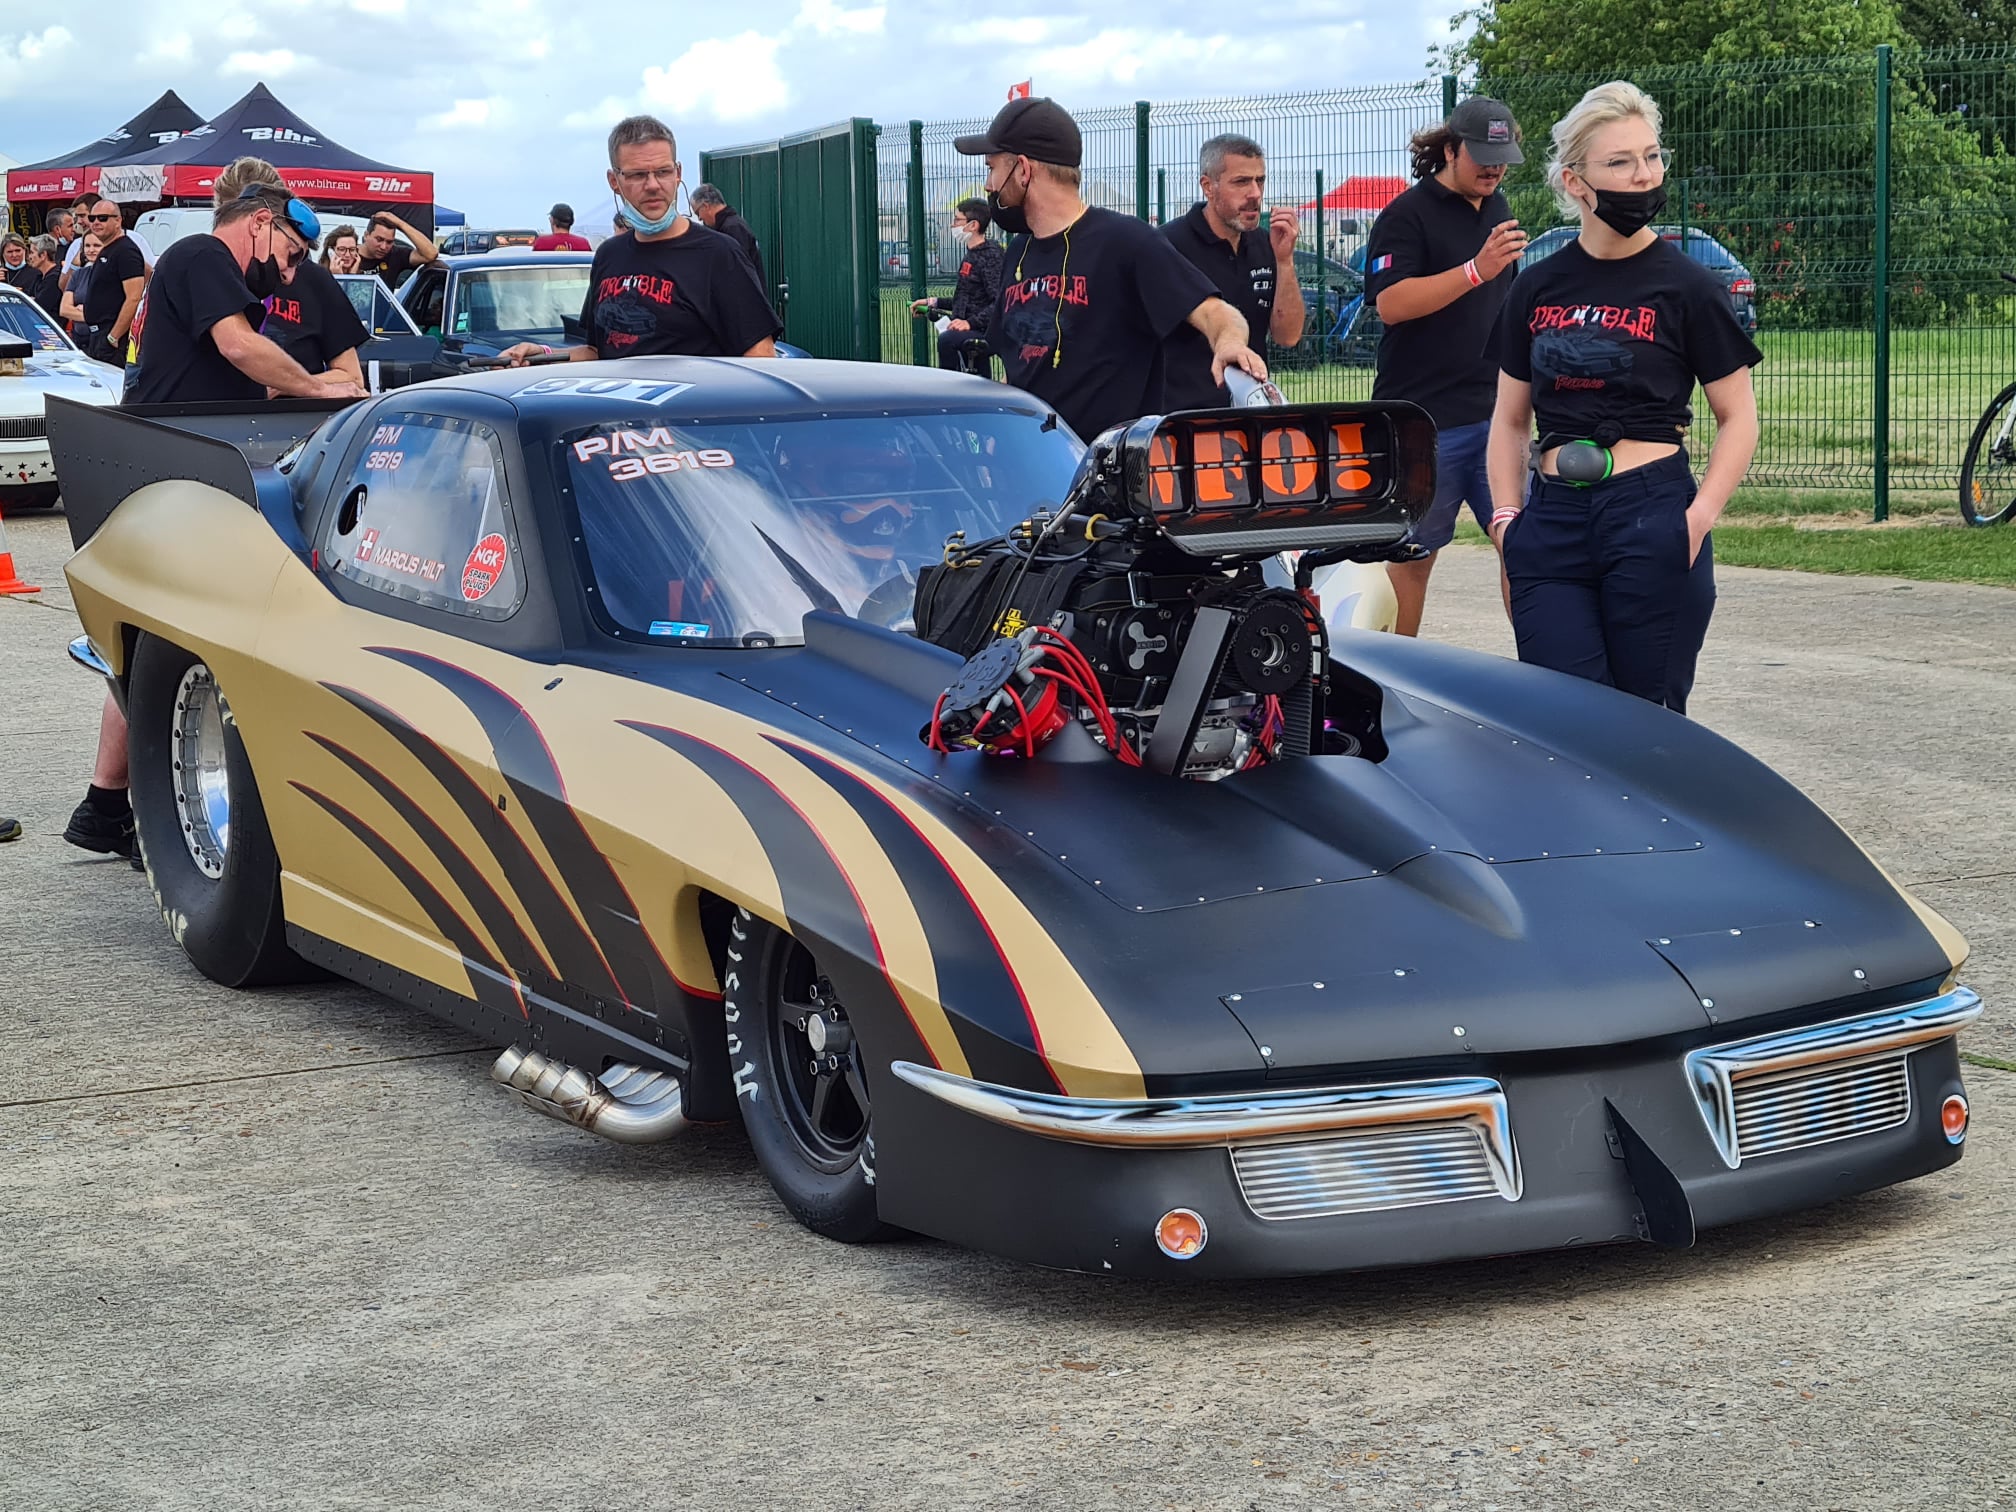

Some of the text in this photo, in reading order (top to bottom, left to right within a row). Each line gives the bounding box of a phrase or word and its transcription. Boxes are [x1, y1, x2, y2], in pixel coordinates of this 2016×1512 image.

[242, 127, 317, 143] Bihr
[287, 179, 351, 190] www.bihr.eu
[364, 177, 411, 193] Bihr
[370, 425, 405, 446] P/M
[573, 427, 674, 462] P/M
[365, 451, 404, 470] 3619
[608, 448, 735, 482] 3619
[373, 547, 445, 581] MARCUS HILT
[474, 548, 500, 567] NGK
[468, 569, 491, 581] SPARK
[465, 579, 488, 591] PLUGS
